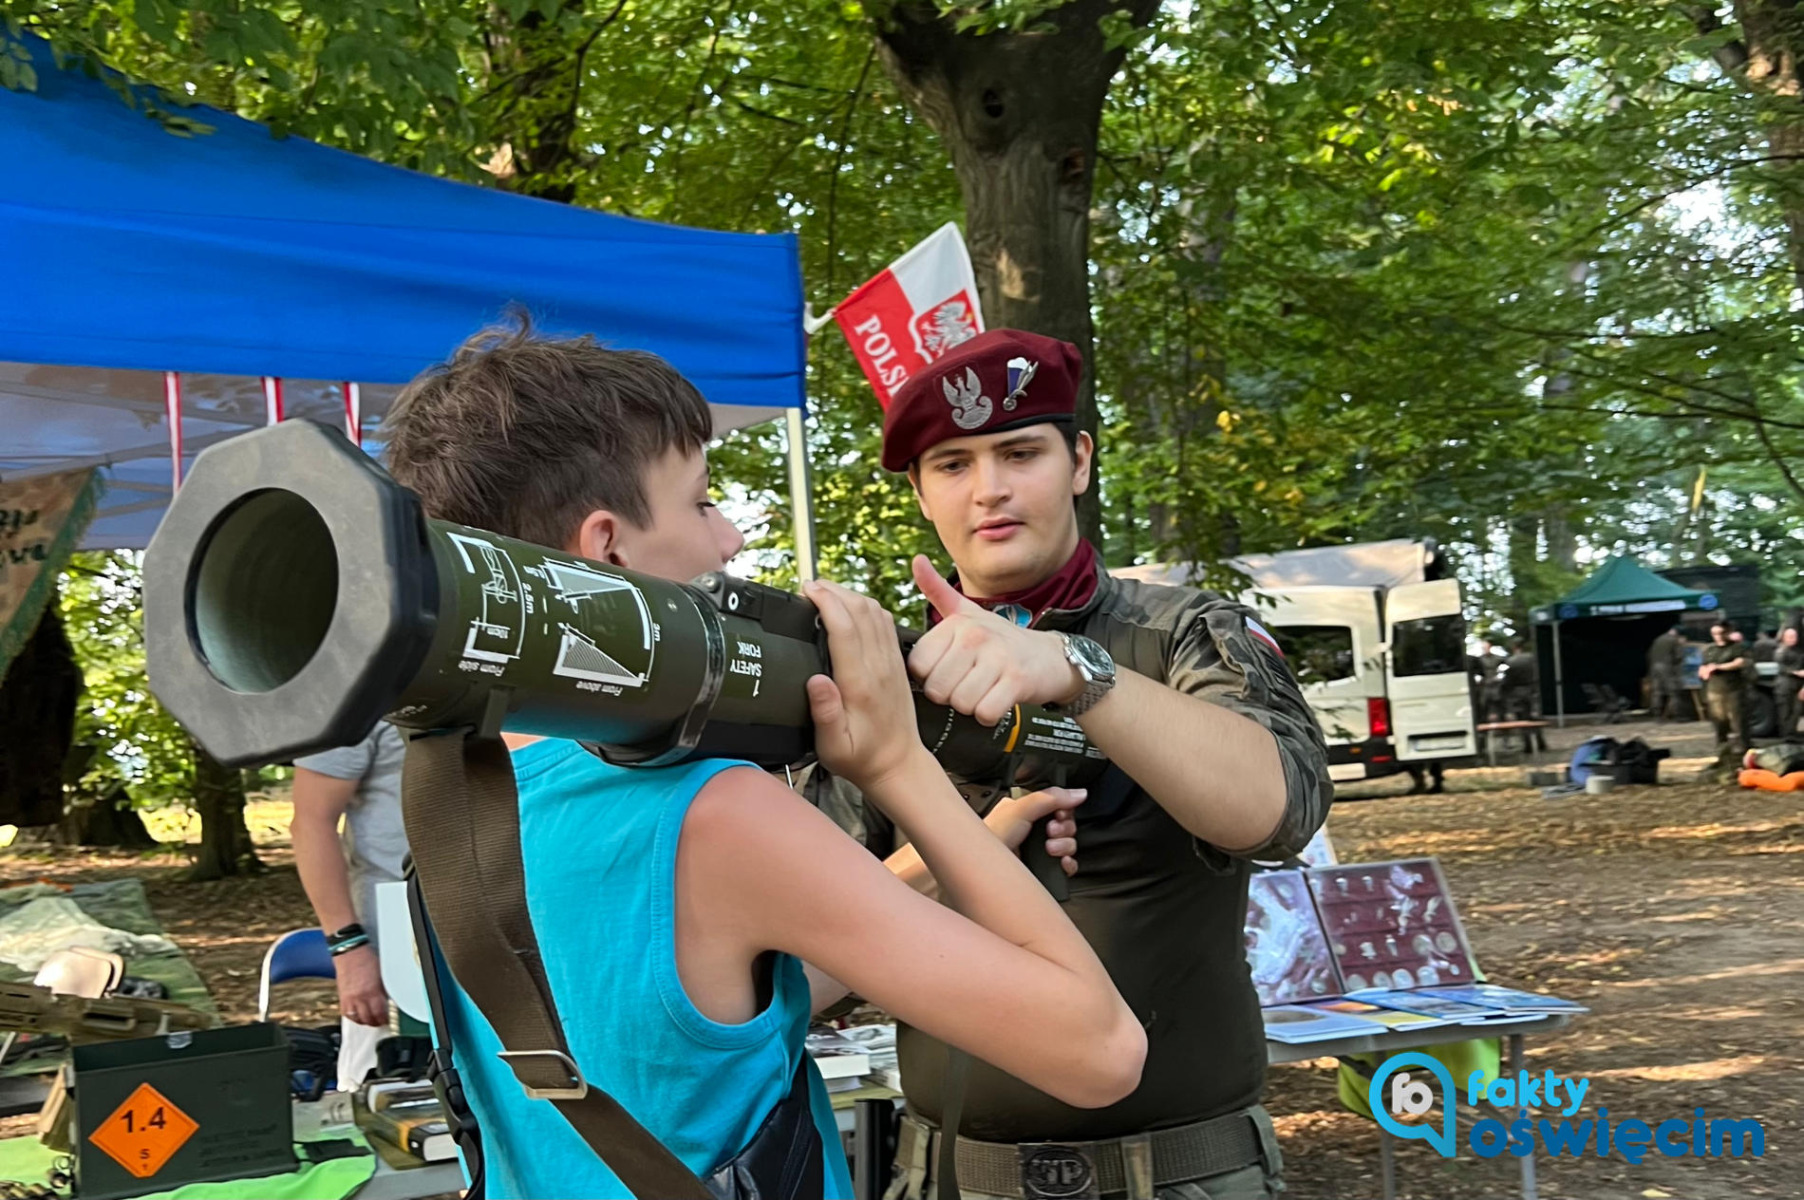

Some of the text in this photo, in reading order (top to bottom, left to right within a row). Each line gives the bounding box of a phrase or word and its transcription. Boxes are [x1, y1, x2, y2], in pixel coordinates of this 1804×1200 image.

[736, 641, 762, 659] FORK
[457, 660, 506, 677] From side
[729, 658, 763, 678] SAFETY
[575, 680, 624, 697] From above
[752, 679, 761, 698] 1
[120, 1106, 167, 1134] 1.4
